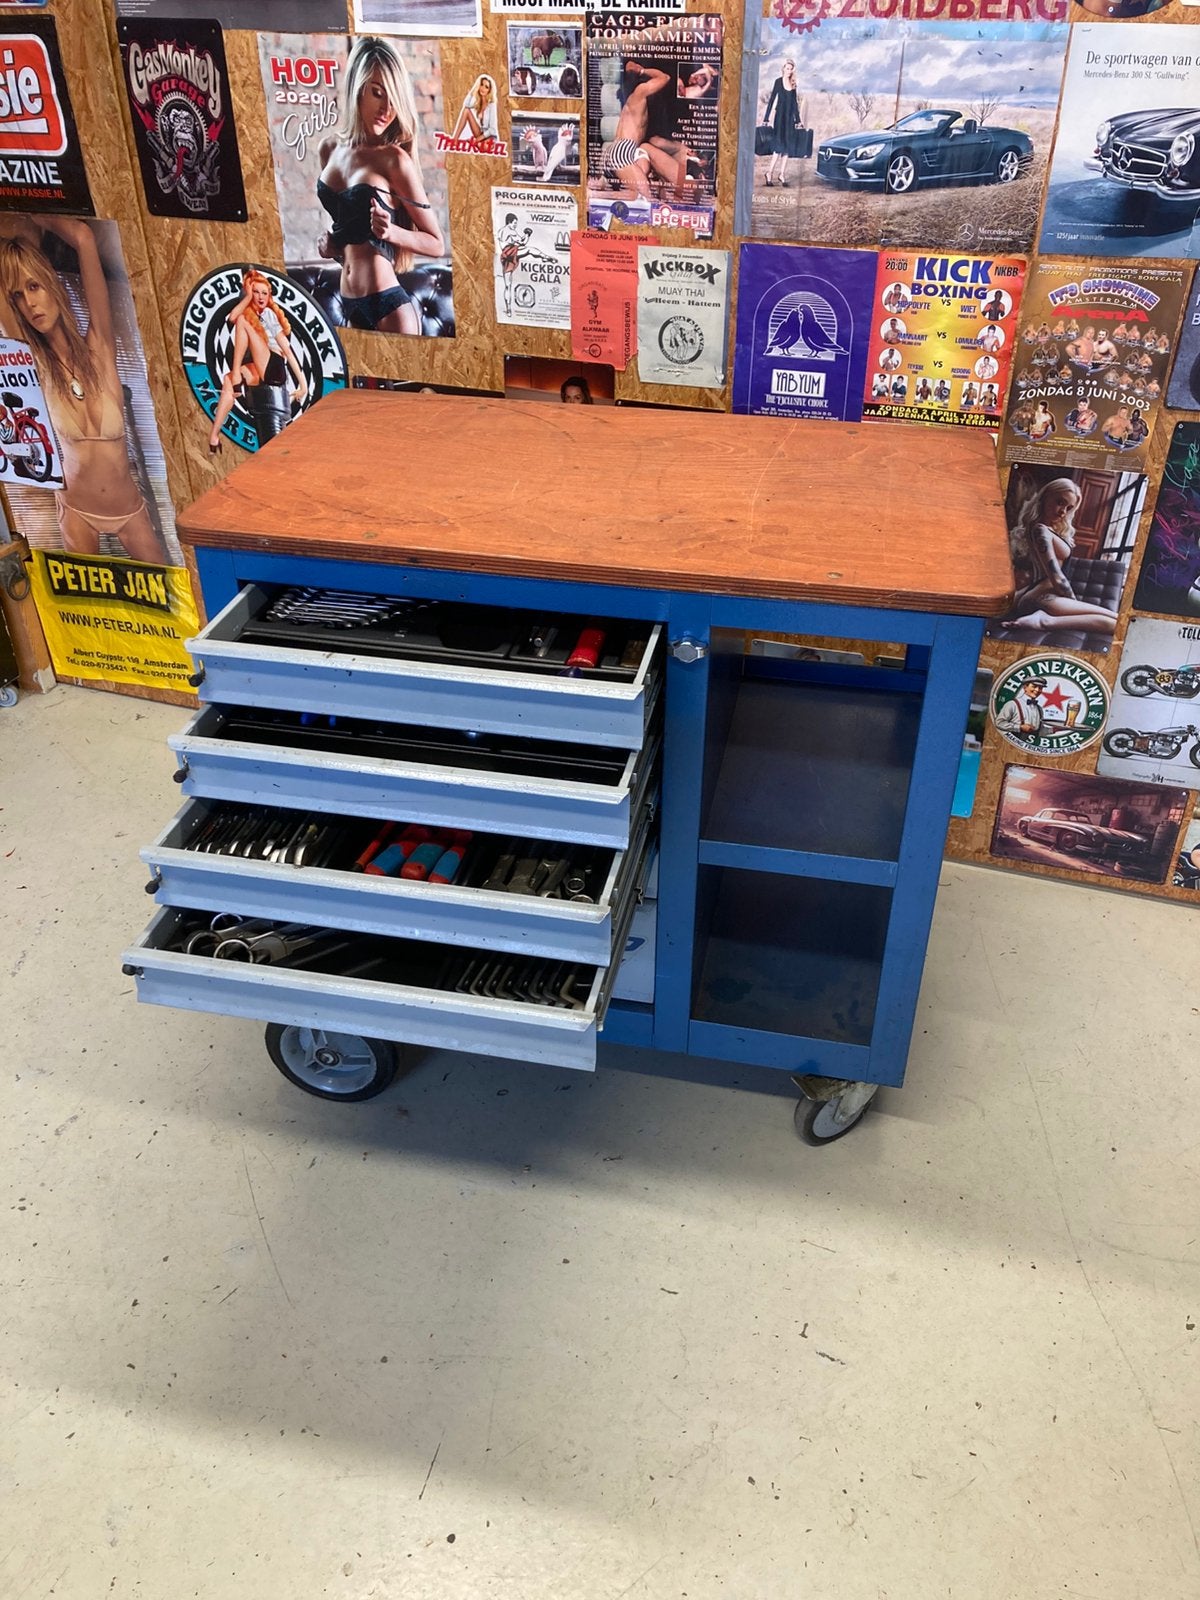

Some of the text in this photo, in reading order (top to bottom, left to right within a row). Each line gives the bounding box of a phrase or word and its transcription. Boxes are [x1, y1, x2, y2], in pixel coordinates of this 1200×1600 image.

[591, 27, 719, 44] TOURNAMENT
[692, 46, 721, 54] EMMEN
[1086, 50, 1101, 65] De
[1104, 53, 1168, 68] sportwagen
[1172, 55, 1192, 66] van
[269, 56, 338, 87] HOT
[1083, 69, 1129, 79] Mercedes-Benz
[1132, 70, 1143, 78] 300
[151, 79, 206, 108] Garage
[275, 90, 321, 105] 2020
[282, 95, 337, 160] Girls
[0, 160, 63, 184] AZINE
[495, 191, 575, 204] PROGRAMMA
[531, 214, 554, 223] WRZV
[681, 214, 709, 228] FUN
[582, 232, 609, 241] ZONDAG
[619, 234, 634, 242] JUNI
[520, 262, 570, 276] KICKBOX
[643, 259, 722, 286] KICKBOX
[885, 261, 908, 271] 20:00
[915, 256, 994, 285] KICK
[994, 265, 1019, 278] NKBB
[530, 273, 561, 284] GALA
[658, 286, 706, 298] MUAY THAI
[910, 282, 988, 300] BOXING
[1081, 279, 1160, 311] SHOWTIME
[688, 299, 721, 308] Hattem
[941, 298, 952, 306] VS
[1066, 297, 1138, 309] AMSTERDAM
[184, 273, 243, 353] BIGGER
[266, 276, 336, 362] SPARK
[937, 331, 947, 339] VS
[776, 371, 822, 395] YAB YUM
[1018, 386, 1151, 411] ZONDAG 8 JUNI 2003
[864, 408, 889, 416] JAAP
[892, 411, 936, 422] EDENHAL
[938, 416, 1000, 427] AMSTERDAM
[880, 405, 918, 415] ZONDAG
[931, 410, 958, 418] APRIL
[48, 559, 167, 606] PETER JAN
[58, 611, 181, 640] WWW.PETERJAN.NL
[73, 648, 94, 657] Albert
[144, 659, 188, 670] Amsterdam
[1160, 674, 1171, 683] 83
[1040, 732, 1084, 748] BIER
